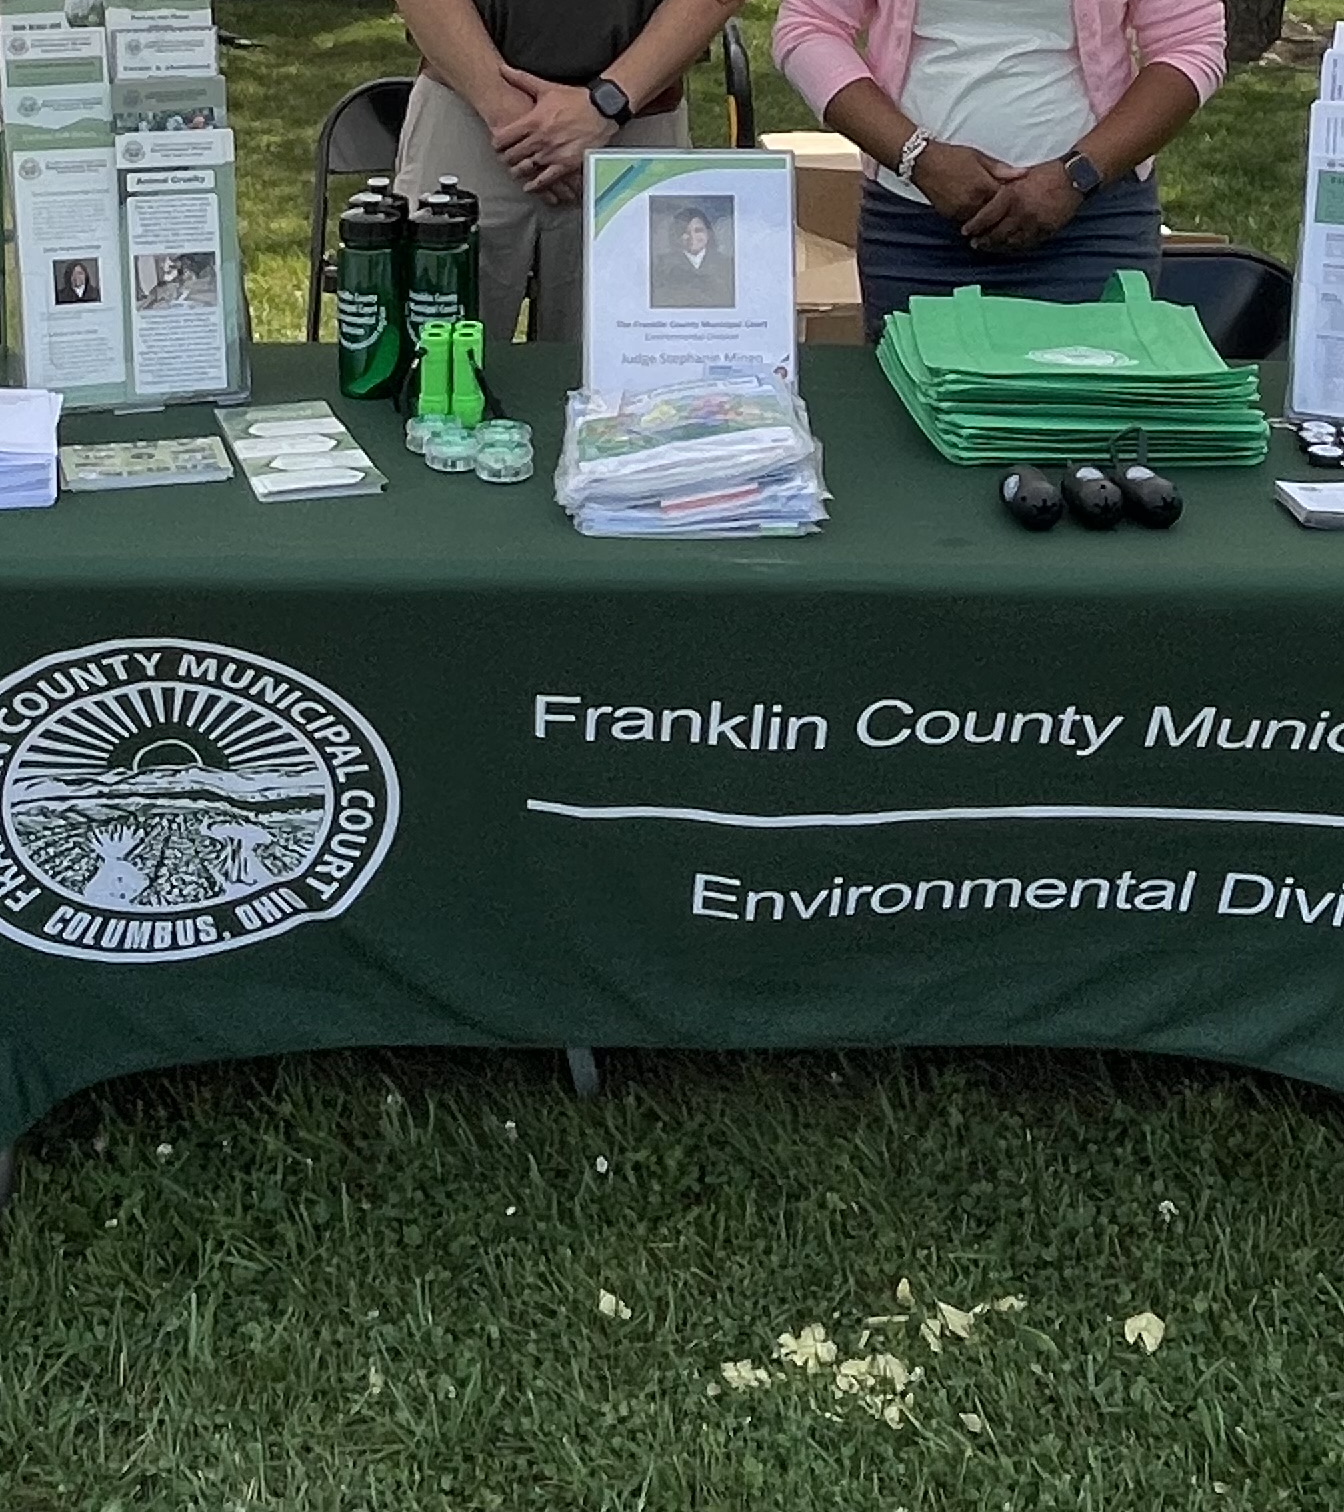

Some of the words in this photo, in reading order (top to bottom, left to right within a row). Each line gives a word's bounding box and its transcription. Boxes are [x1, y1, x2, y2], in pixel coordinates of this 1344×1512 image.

[534, 694, 828, 751] Franklin
[856, 699, 1124, 756] County
[178, 654, 370, 784] MUNICIPAL
[305, 789, 376, 902] COURT
[691, 870, 1197, 922] Environmental
